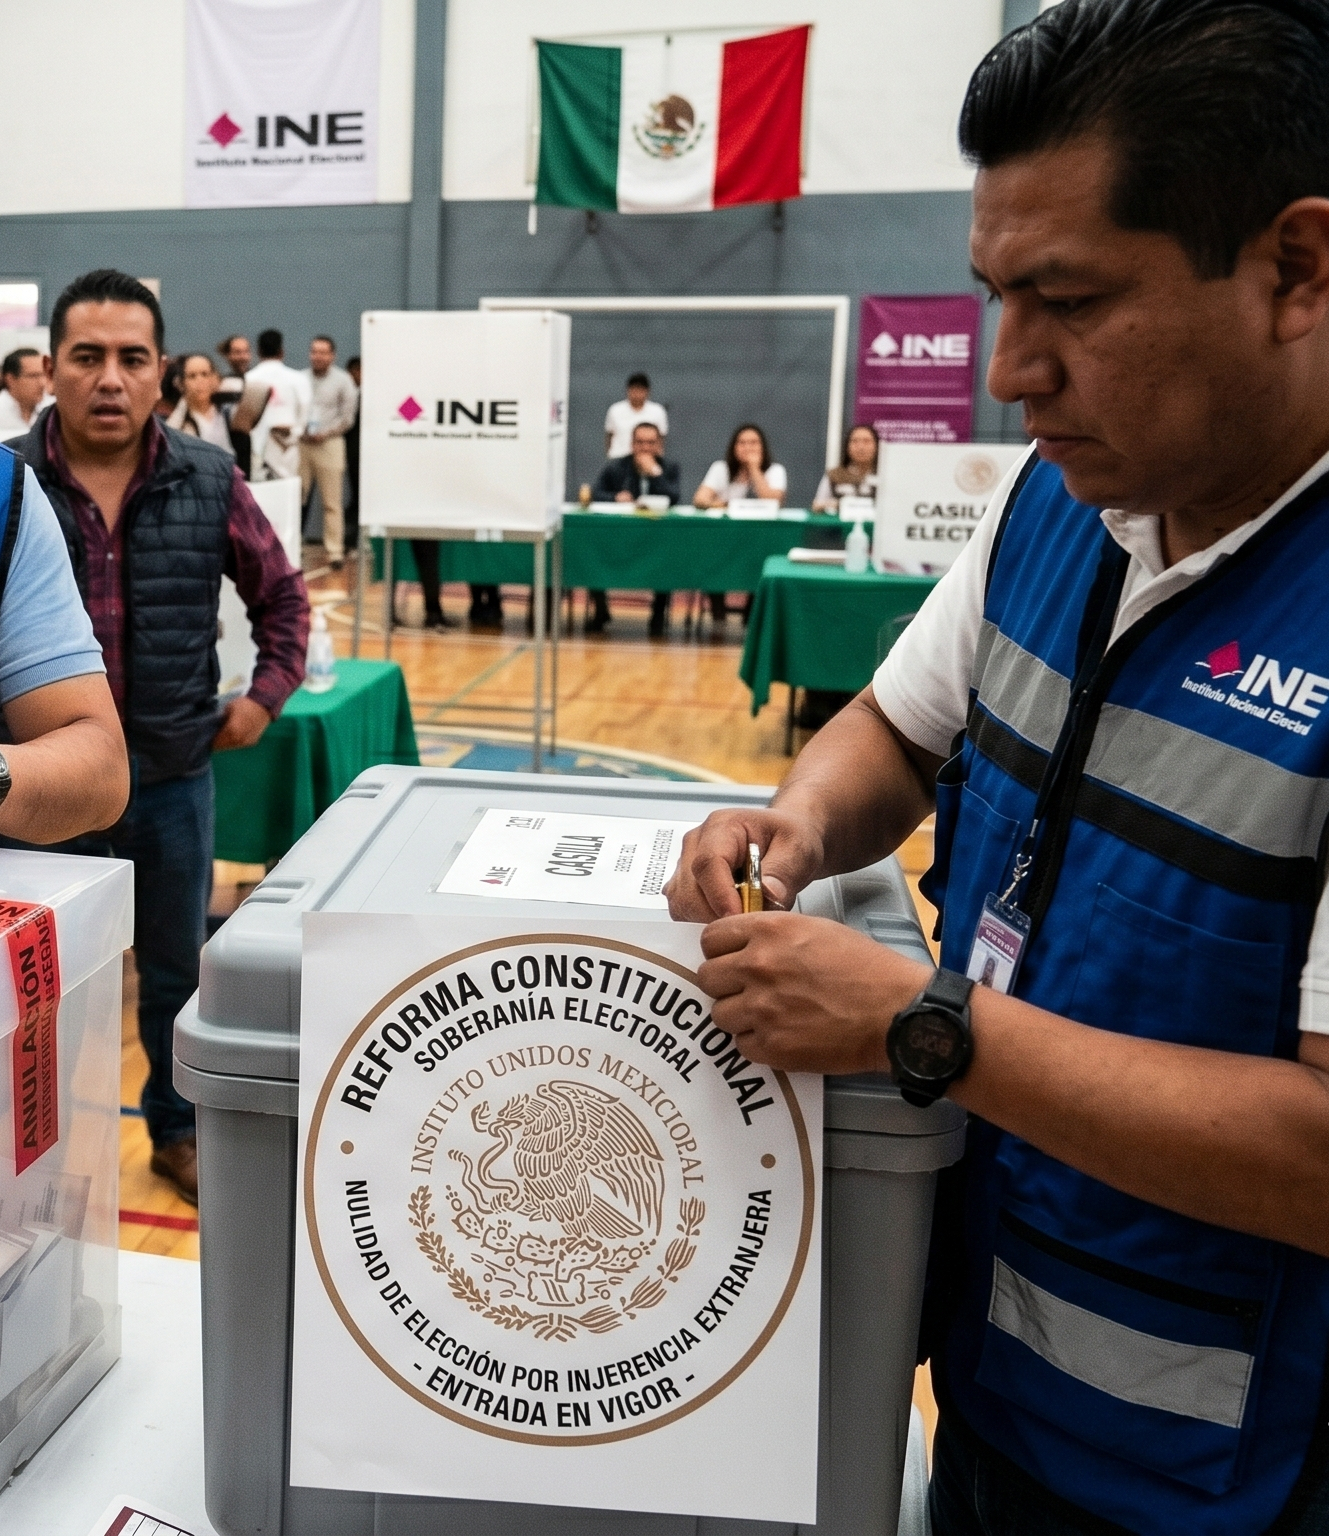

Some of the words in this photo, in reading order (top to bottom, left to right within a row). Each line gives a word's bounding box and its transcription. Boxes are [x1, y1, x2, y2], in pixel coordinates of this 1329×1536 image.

[257, 112, 365, 148] INE
[901, 334, 971, 358] INE
[436, 400, 518, 426] INE
[905, 524, 976, 542] ELECT
[913, 502, 989, 521] CASIL
[1235, 653, 1329, 719] INE
[544, 834, 606, 878] CASILLA
[19, 945, 41, 1150] ANULACIÓN
[340, 971, 485, 1113] REFORMA
[490, 954, 775, 1127] CONSTITUCIONAL
[413, 990, 556, 1074] SOBERANÍA
[563, 996, 701, 1084] ELECTORAL
[410, 1068, 485, 1175] INSTITUTO
[486, 1044, 593, 1079] UNIDOS
[345, 1179, 391, 1281] NULIDAD
[379, 1280, 413, 1316] DE
[402, 1309, 507, 1385] ELECCIÓN
[511, 1364, 560, 1393] POR
[567, 1327, 702, 1394] INJERENCIA
[693, 1188, 773, 1334] EXTRANJERA
[425, 1365, 548, 1428] ENTRADA
[557, 1401, 591, 1428] EN
[597, 1376, 683, 1424] VIGOR
